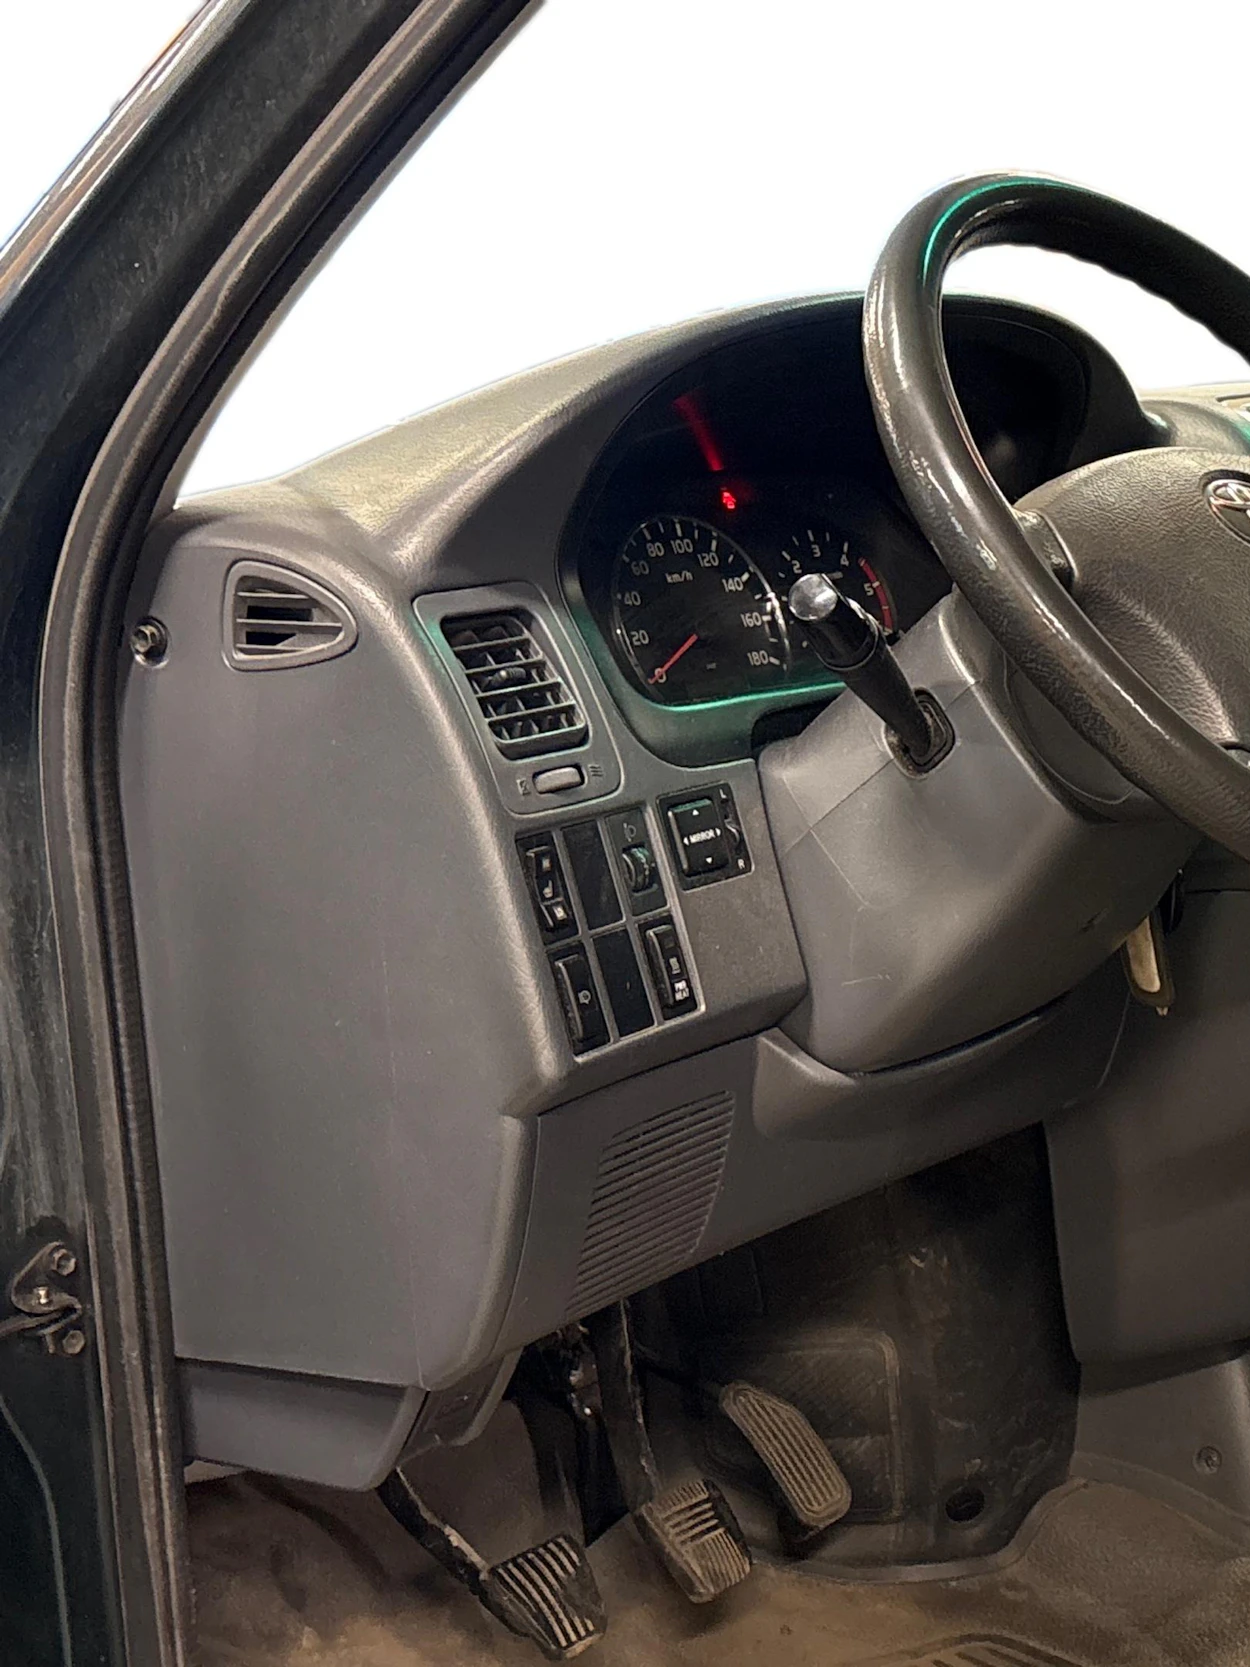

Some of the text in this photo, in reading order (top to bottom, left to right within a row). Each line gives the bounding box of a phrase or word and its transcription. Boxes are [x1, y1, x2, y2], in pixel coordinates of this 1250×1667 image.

[646, 542, 665, 557] 80
[670, 538, 694, 554] 100
[811, 543, 821, 558] 3
[697, 552, 719, 567] 120
[791, 560, 802, 574] 2
[840, 553, 850, 567] 4
[631, 560, 649, 576] 60
[665, 570, 693, 583] km/h
[722, 576, 744, 592] 140
[863, 582, 875, 596] 5
[624, 591, 641, 606] 40
[741, 611, 762, 628] 160
[630, 629, 649, 646] 20
[747, 650, 769, 666] 180
[719, 788, 728, 799] L
[689, 828, 716, 844] MIRROR
[737, 858, 746, 870] R
